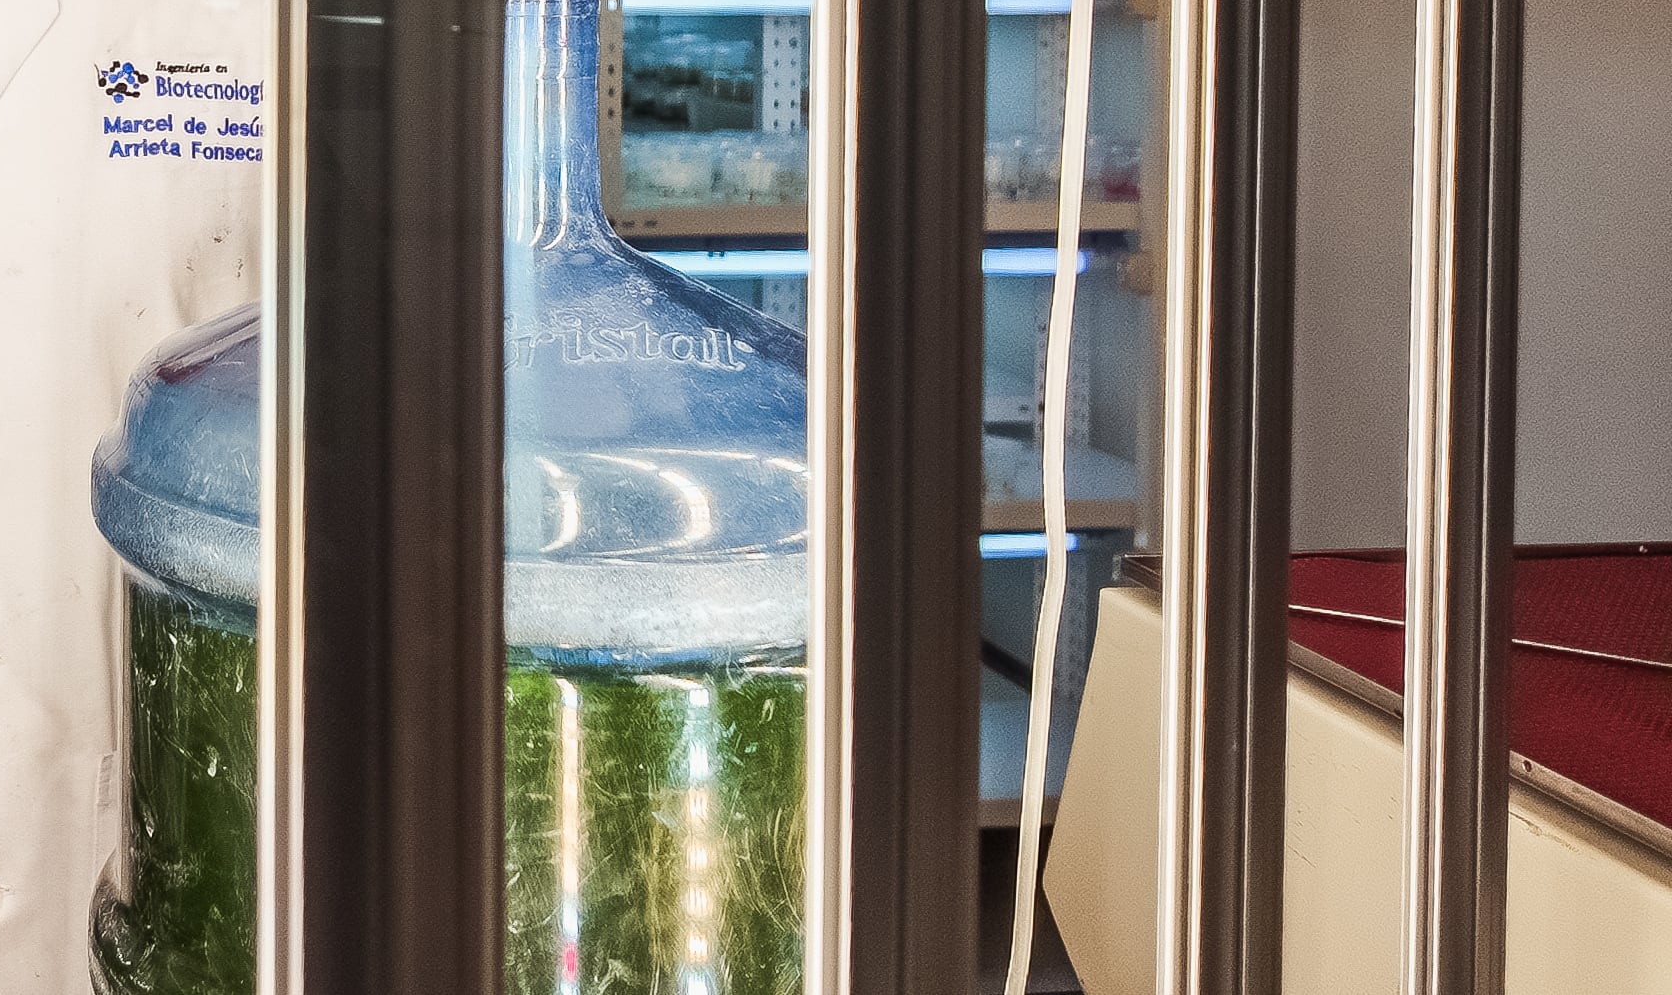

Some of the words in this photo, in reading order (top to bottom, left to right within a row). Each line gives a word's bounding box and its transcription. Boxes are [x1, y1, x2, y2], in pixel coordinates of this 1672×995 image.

[215, 64, 228, 73] en
[103, 113, 173, 135] Marcel
[183, 116, 207, 135] de
[108, 137, 182, 158] Arrieta
[191, 140, 263, 161] Fonseca
[504, 311, 747, 372] ristal
